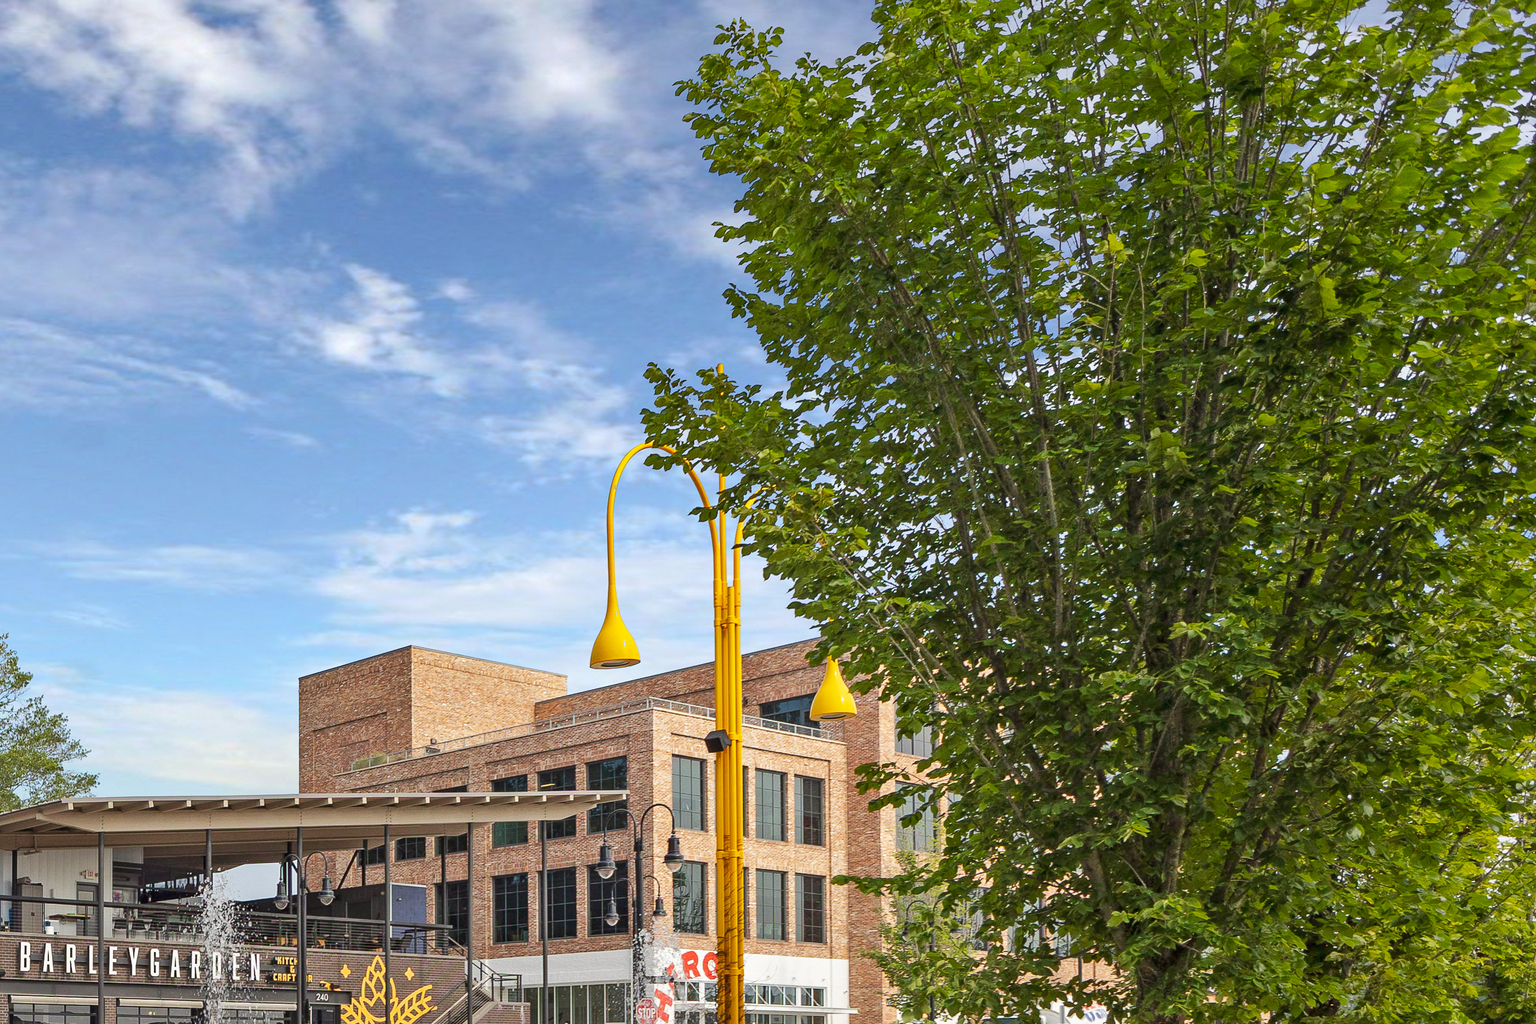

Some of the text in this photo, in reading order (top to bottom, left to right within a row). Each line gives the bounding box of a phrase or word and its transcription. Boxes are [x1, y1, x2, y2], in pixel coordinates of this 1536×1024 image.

[19, 941, 261, 982] BARLEYGARDEN
[316, 993, 329, 1001] 240
[638, 1007, 656, 1020] STOP
